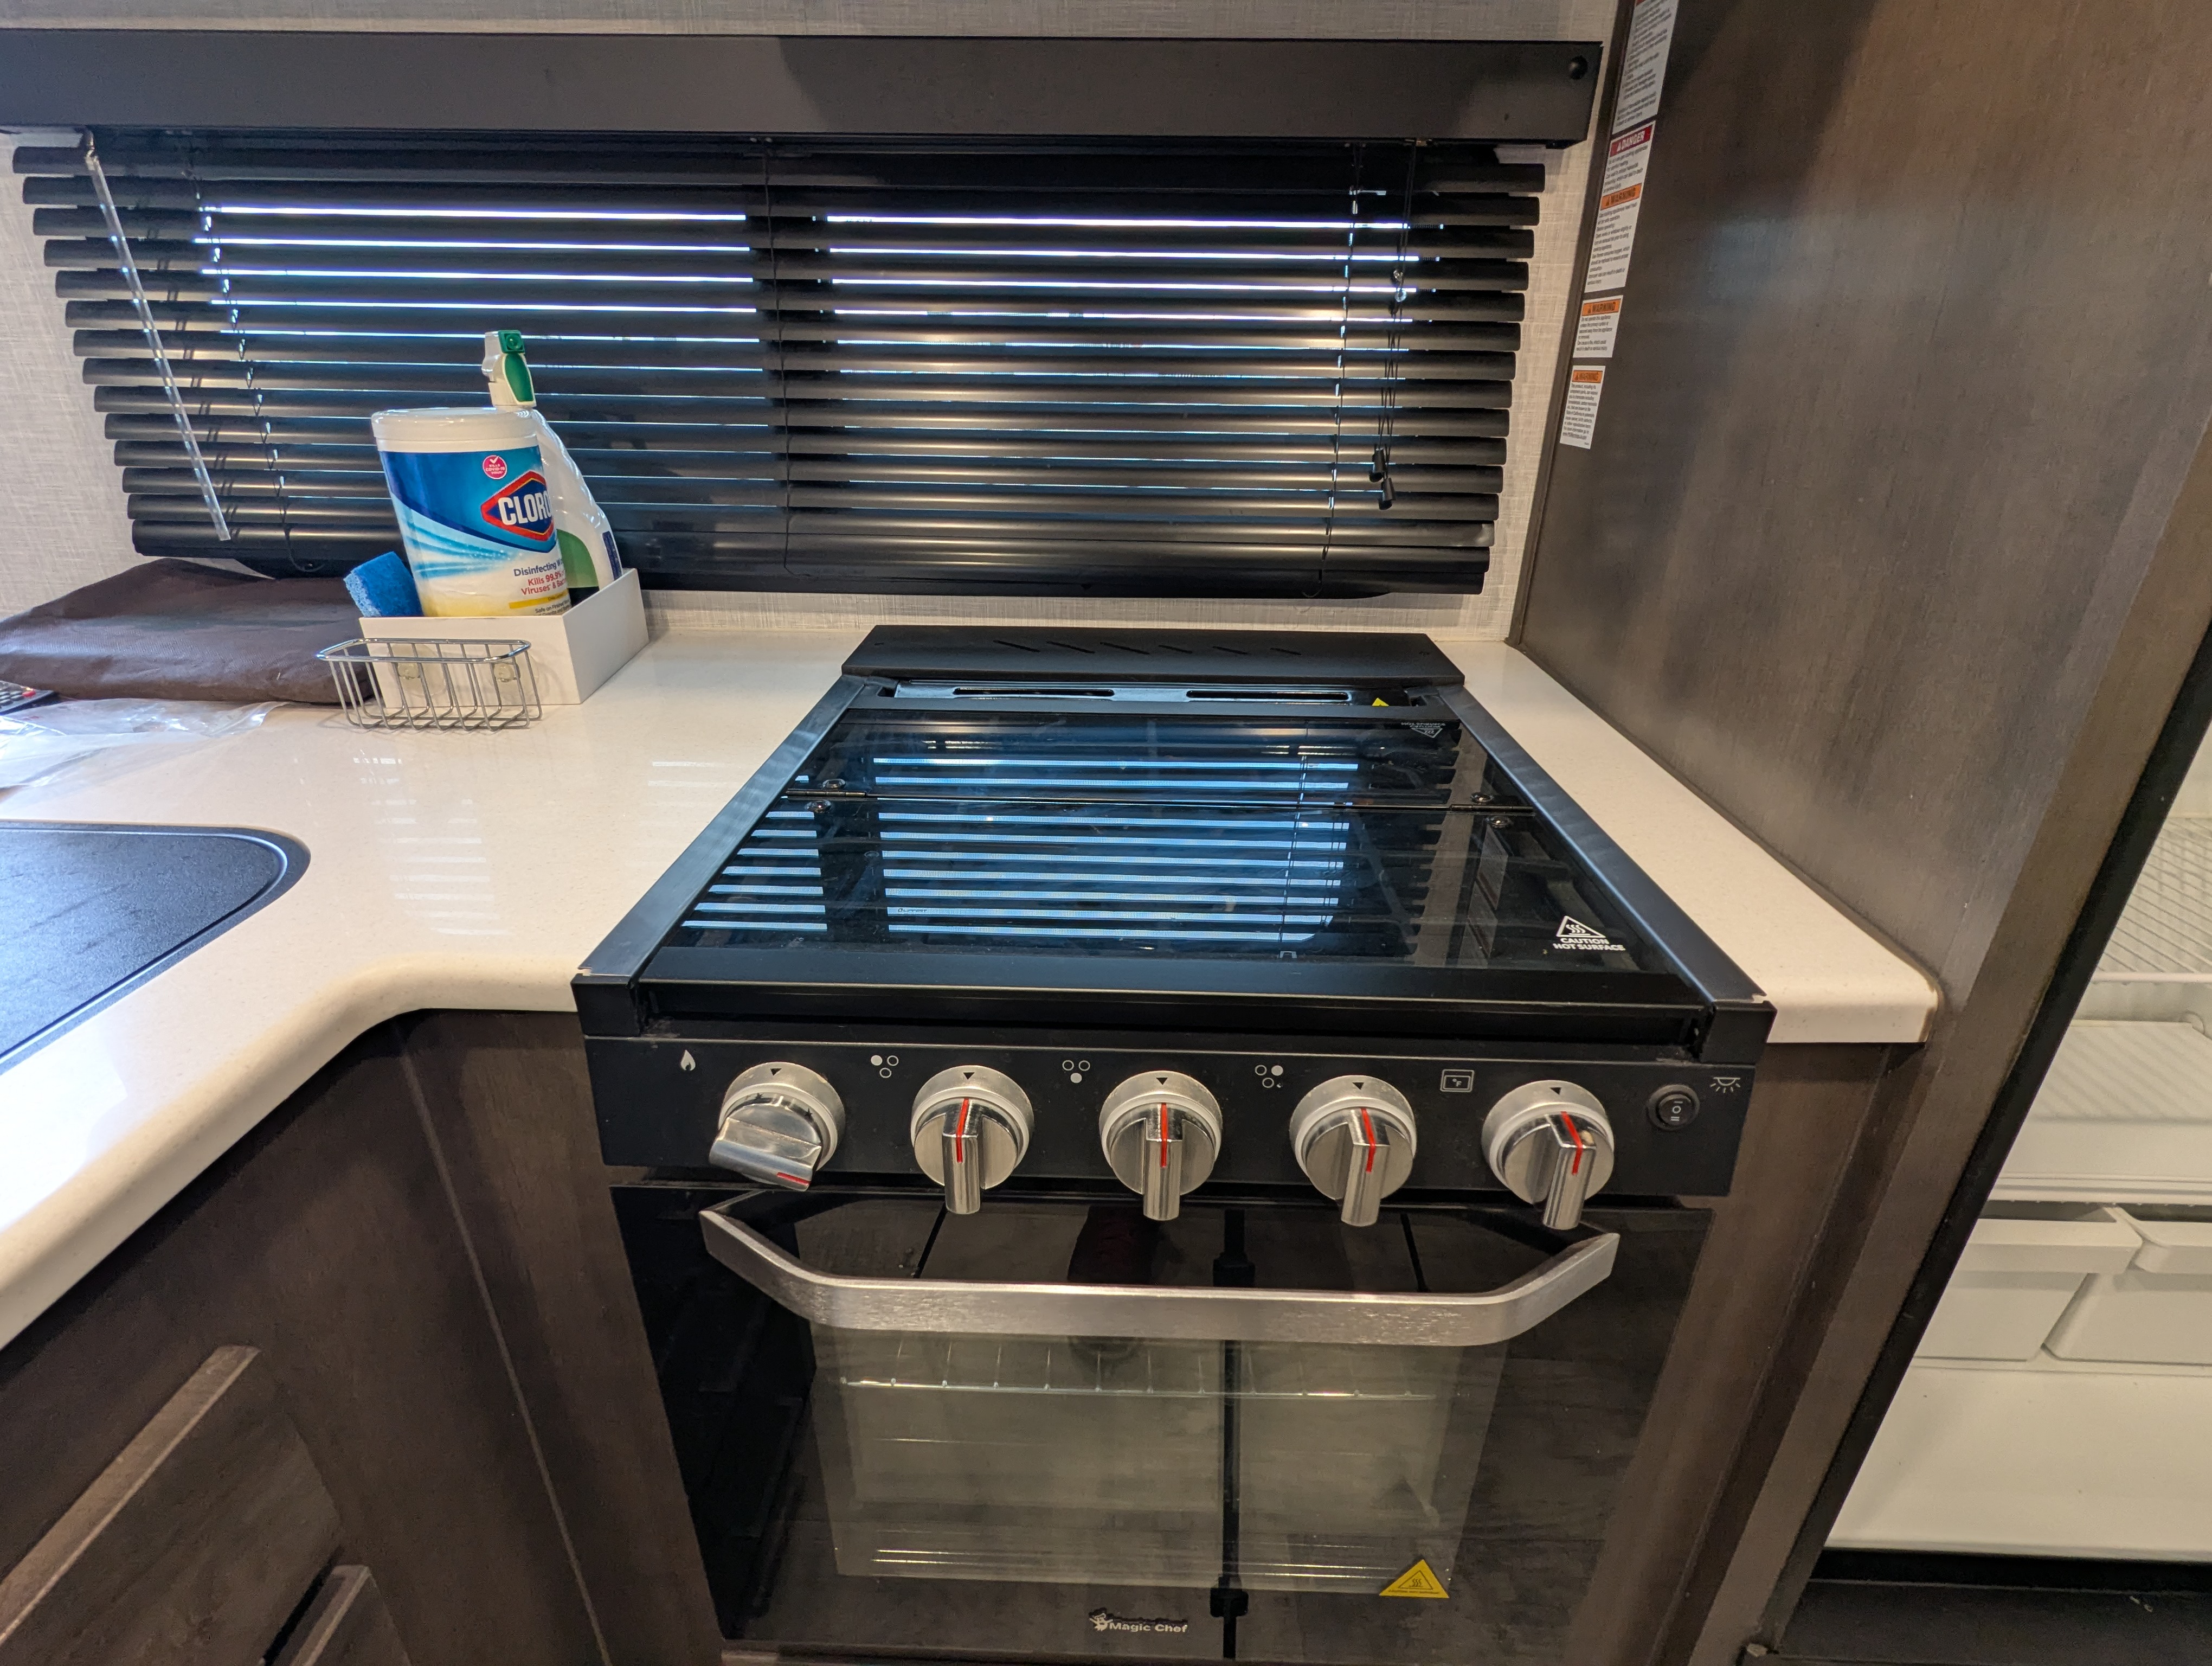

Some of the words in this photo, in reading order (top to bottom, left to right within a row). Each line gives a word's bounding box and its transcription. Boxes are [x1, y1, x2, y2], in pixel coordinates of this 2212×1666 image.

[498, 490, 552, 526] CLORO
[513, 562, 557, 576] Disinfecting
[528, 576, 544, 586] Kills
[1109, 1622, 1151, 1632] Magic
[1154, 1624, 1188, 1632] Chef
